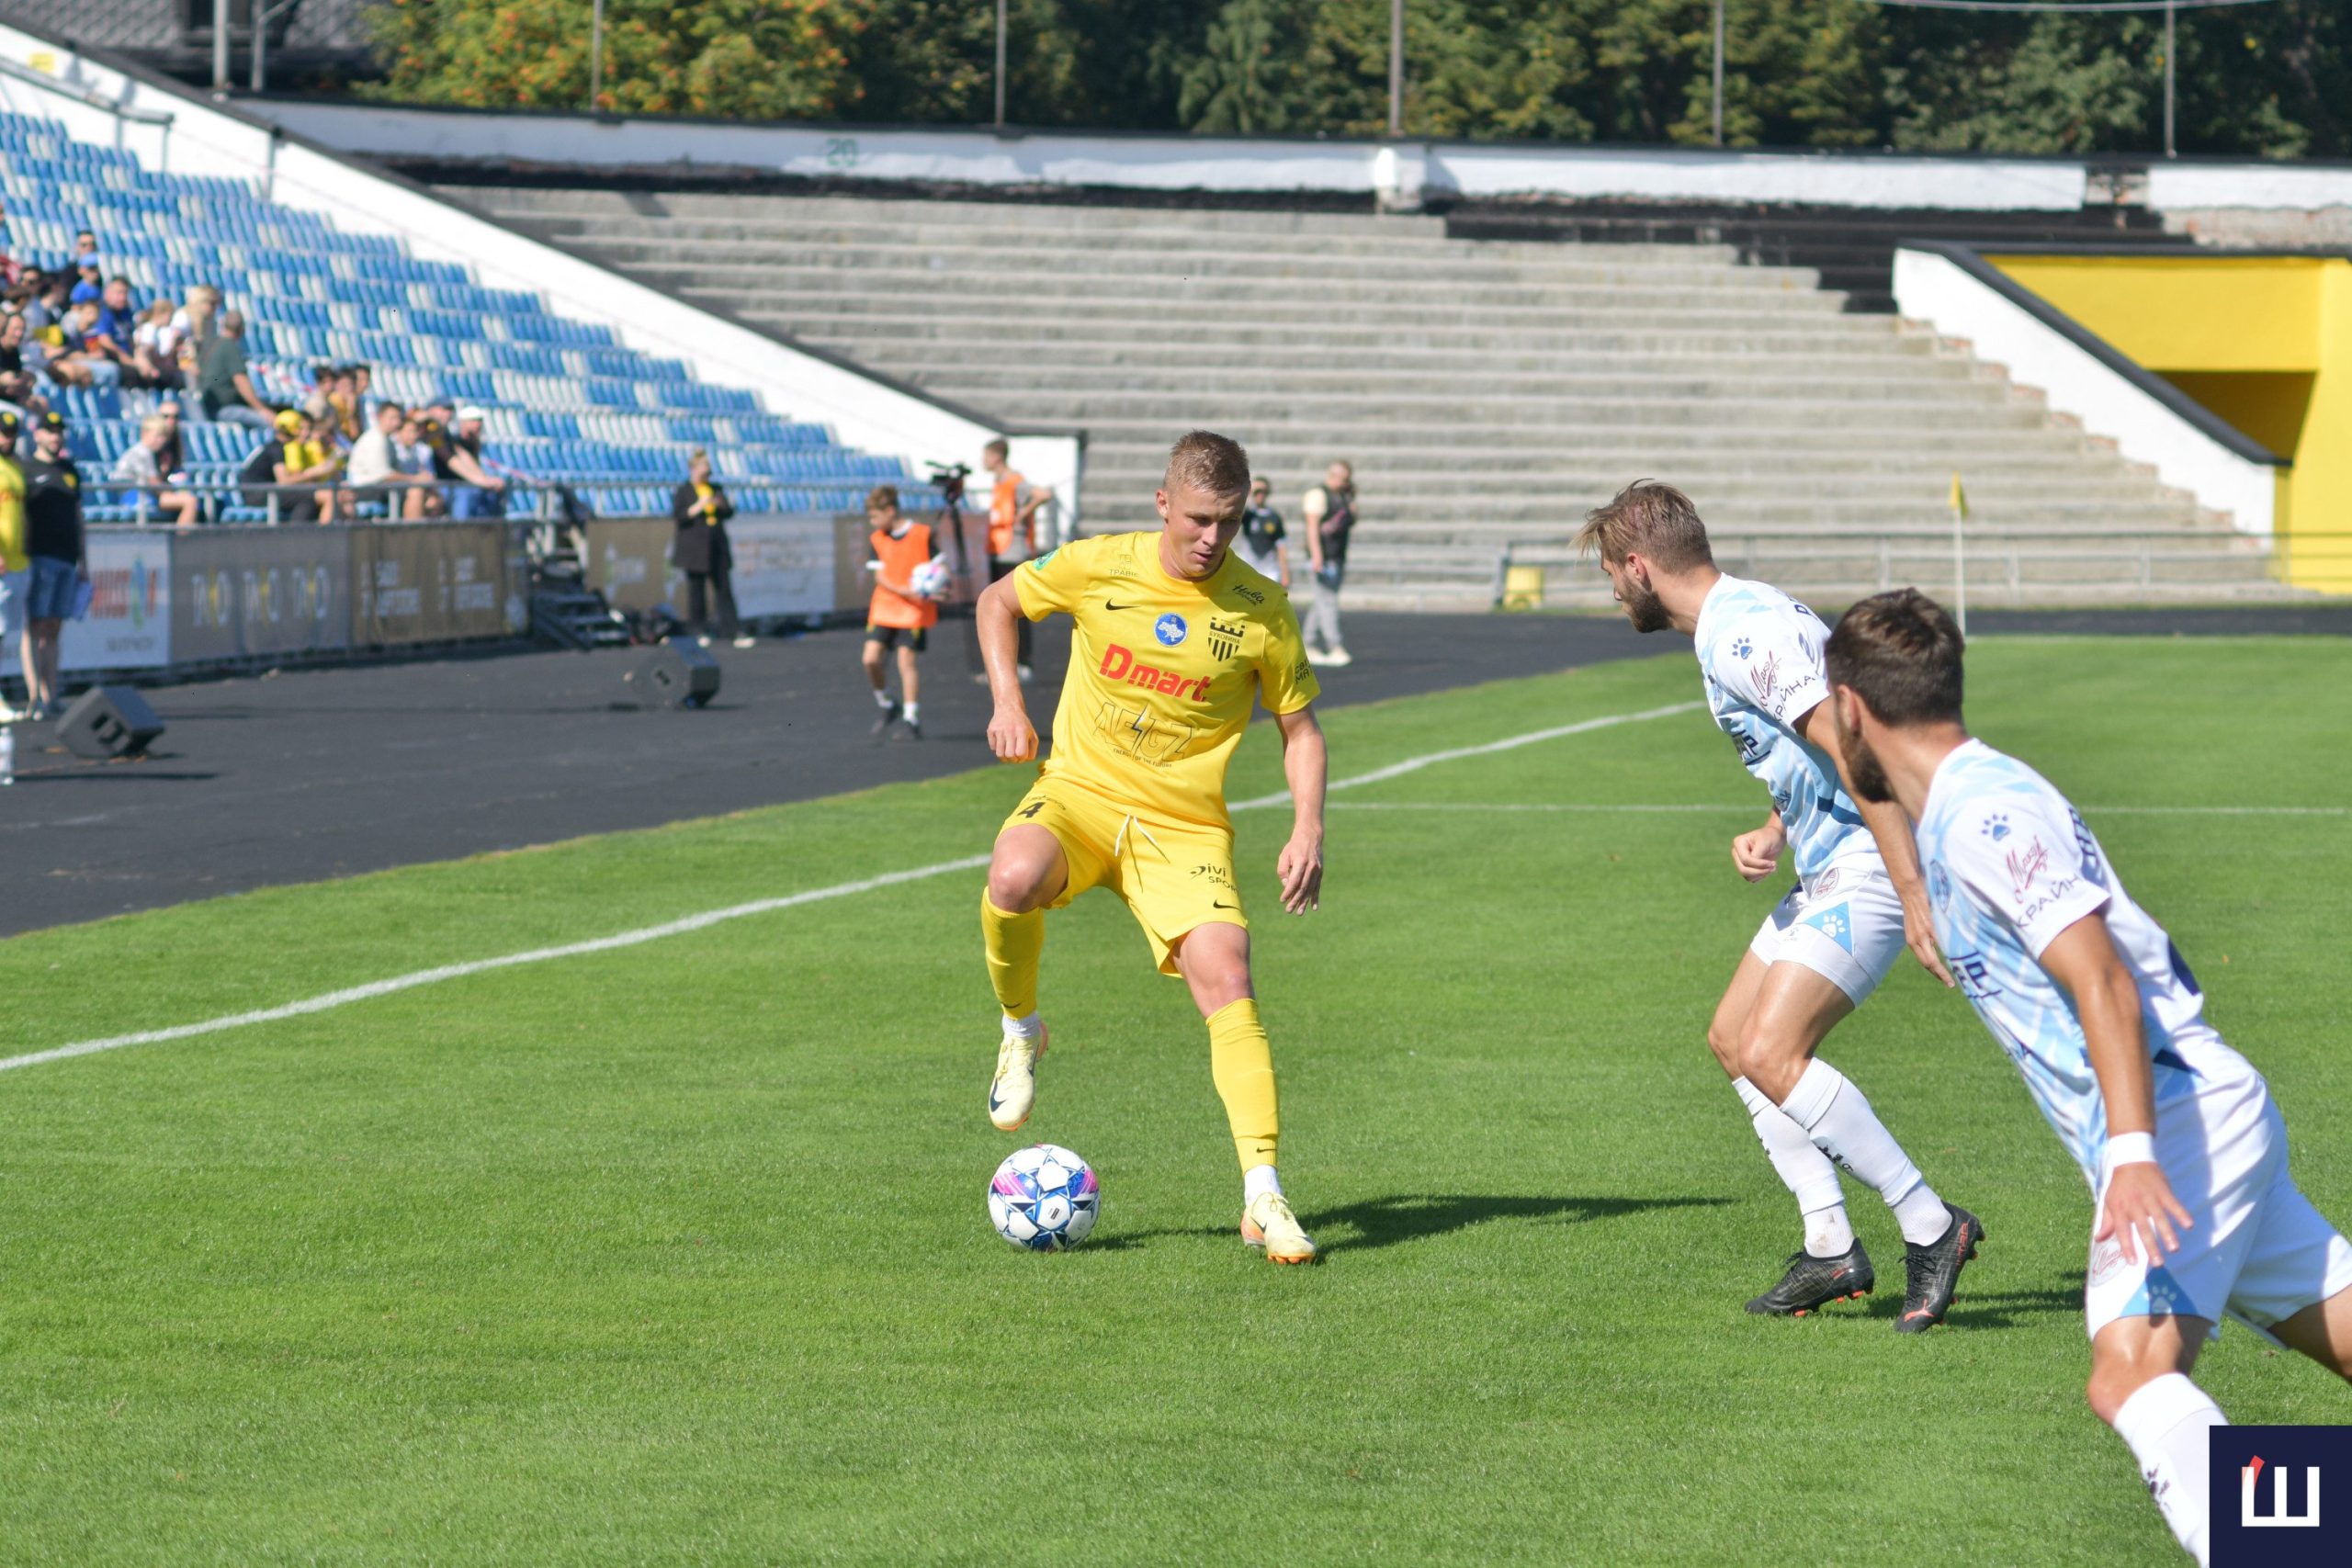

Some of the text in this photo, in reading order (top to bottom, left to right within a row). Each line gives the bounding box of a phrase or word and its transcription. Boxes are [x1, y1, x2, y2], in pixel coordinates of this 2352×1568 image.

[1209, 630, 1240, 644] БУКОВИНА
[1100, 643, 1212, 703] Dmart
[1017, 801, 1046, 818] 4
